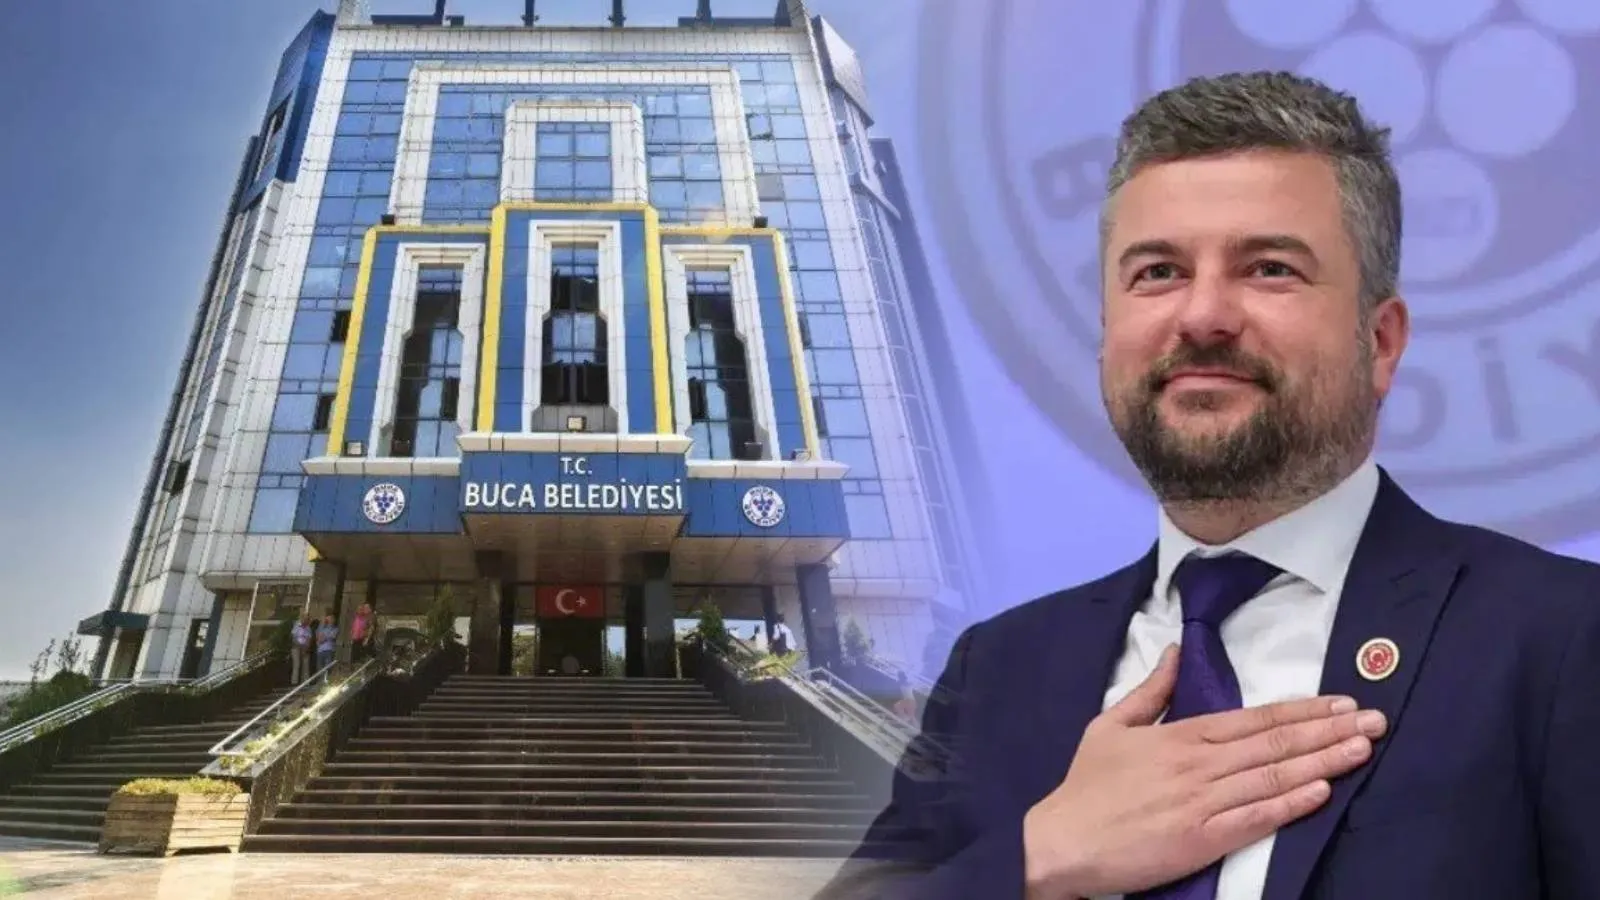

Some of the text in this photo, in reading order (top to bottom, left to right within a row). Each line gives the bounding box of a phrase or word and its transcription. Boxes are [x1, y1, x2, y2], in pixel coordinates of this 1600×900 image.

[560, 457, 592, 474] T.C.
[465, 478, 682, 509] BUCA BELEDİYESİ
